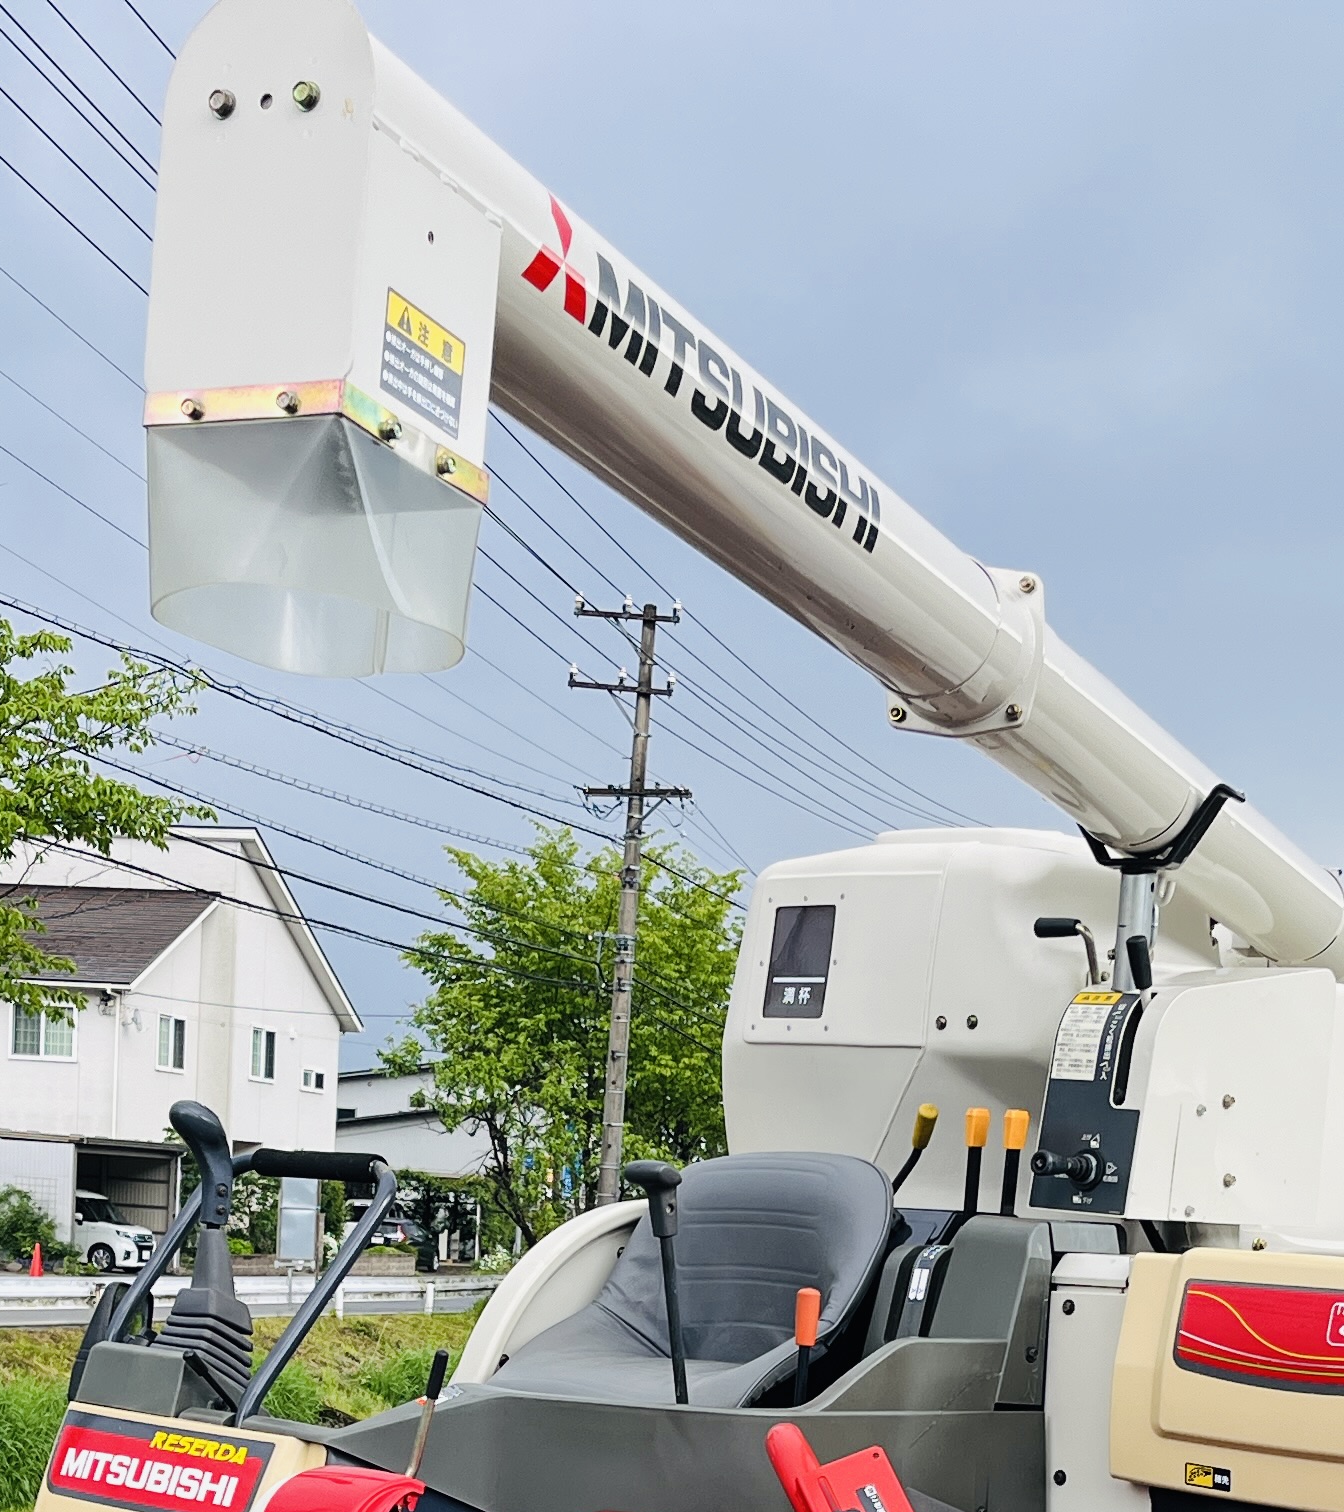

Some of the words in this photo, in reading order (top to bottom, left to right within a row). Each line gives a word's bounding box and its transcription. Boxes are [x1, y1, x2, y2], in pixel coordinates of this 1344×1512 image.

[588, 251, 881, 554] MITSUBISHI
[60, 1447, 239, 1508] MITSUBISHI
[149, 1430, 249, 1465] RESERDA
